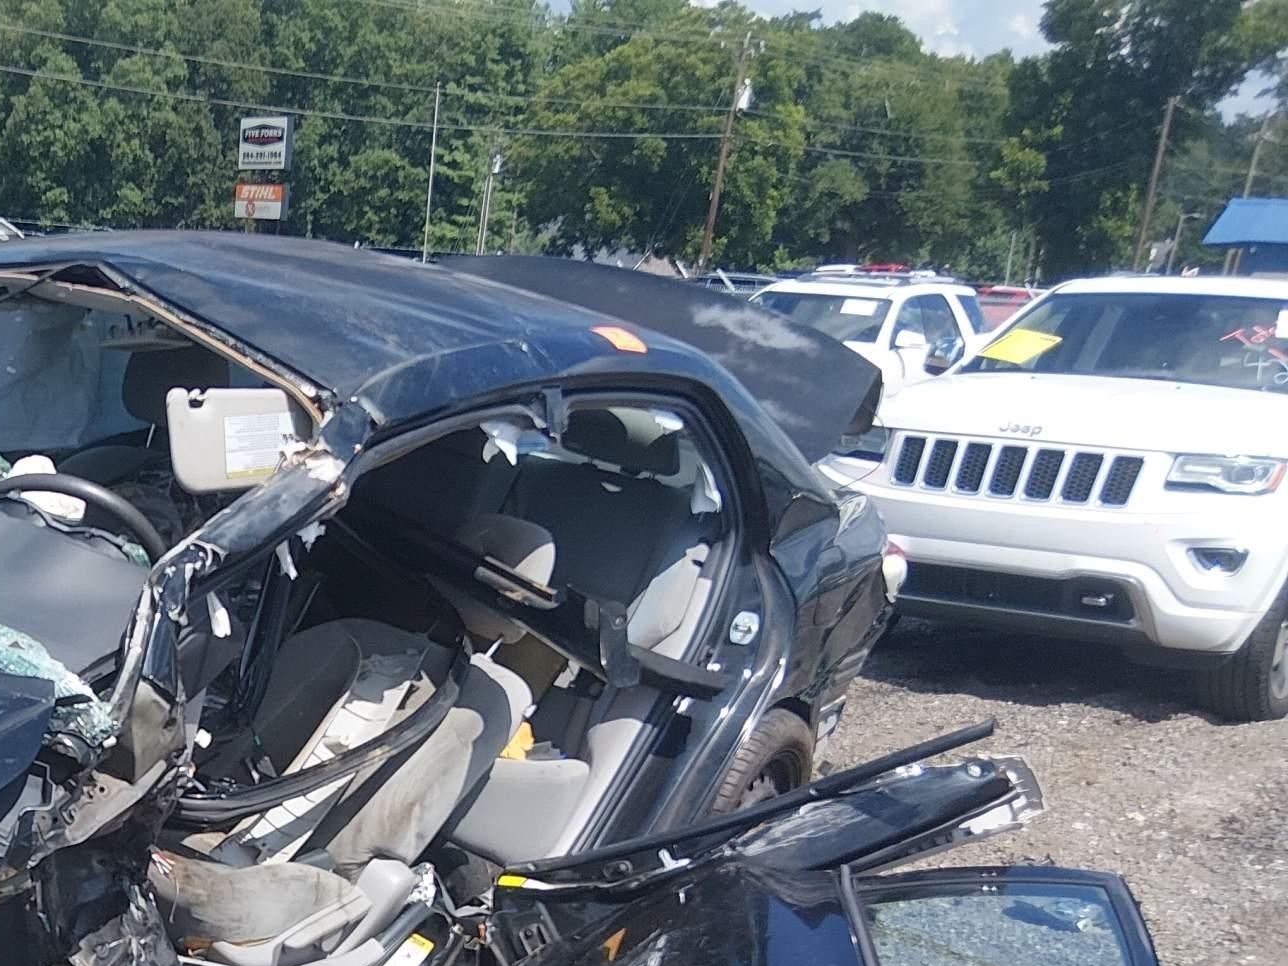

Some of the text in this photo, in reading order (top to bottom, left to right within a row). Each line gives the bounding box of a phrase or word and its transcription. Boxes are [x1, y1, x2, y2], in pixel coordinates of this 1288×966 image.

[244, 128, 282, 138] FIVE FORKS
[240, 184, 276, 200] STIHL
[998, 420, 1043, 438] Jeep
